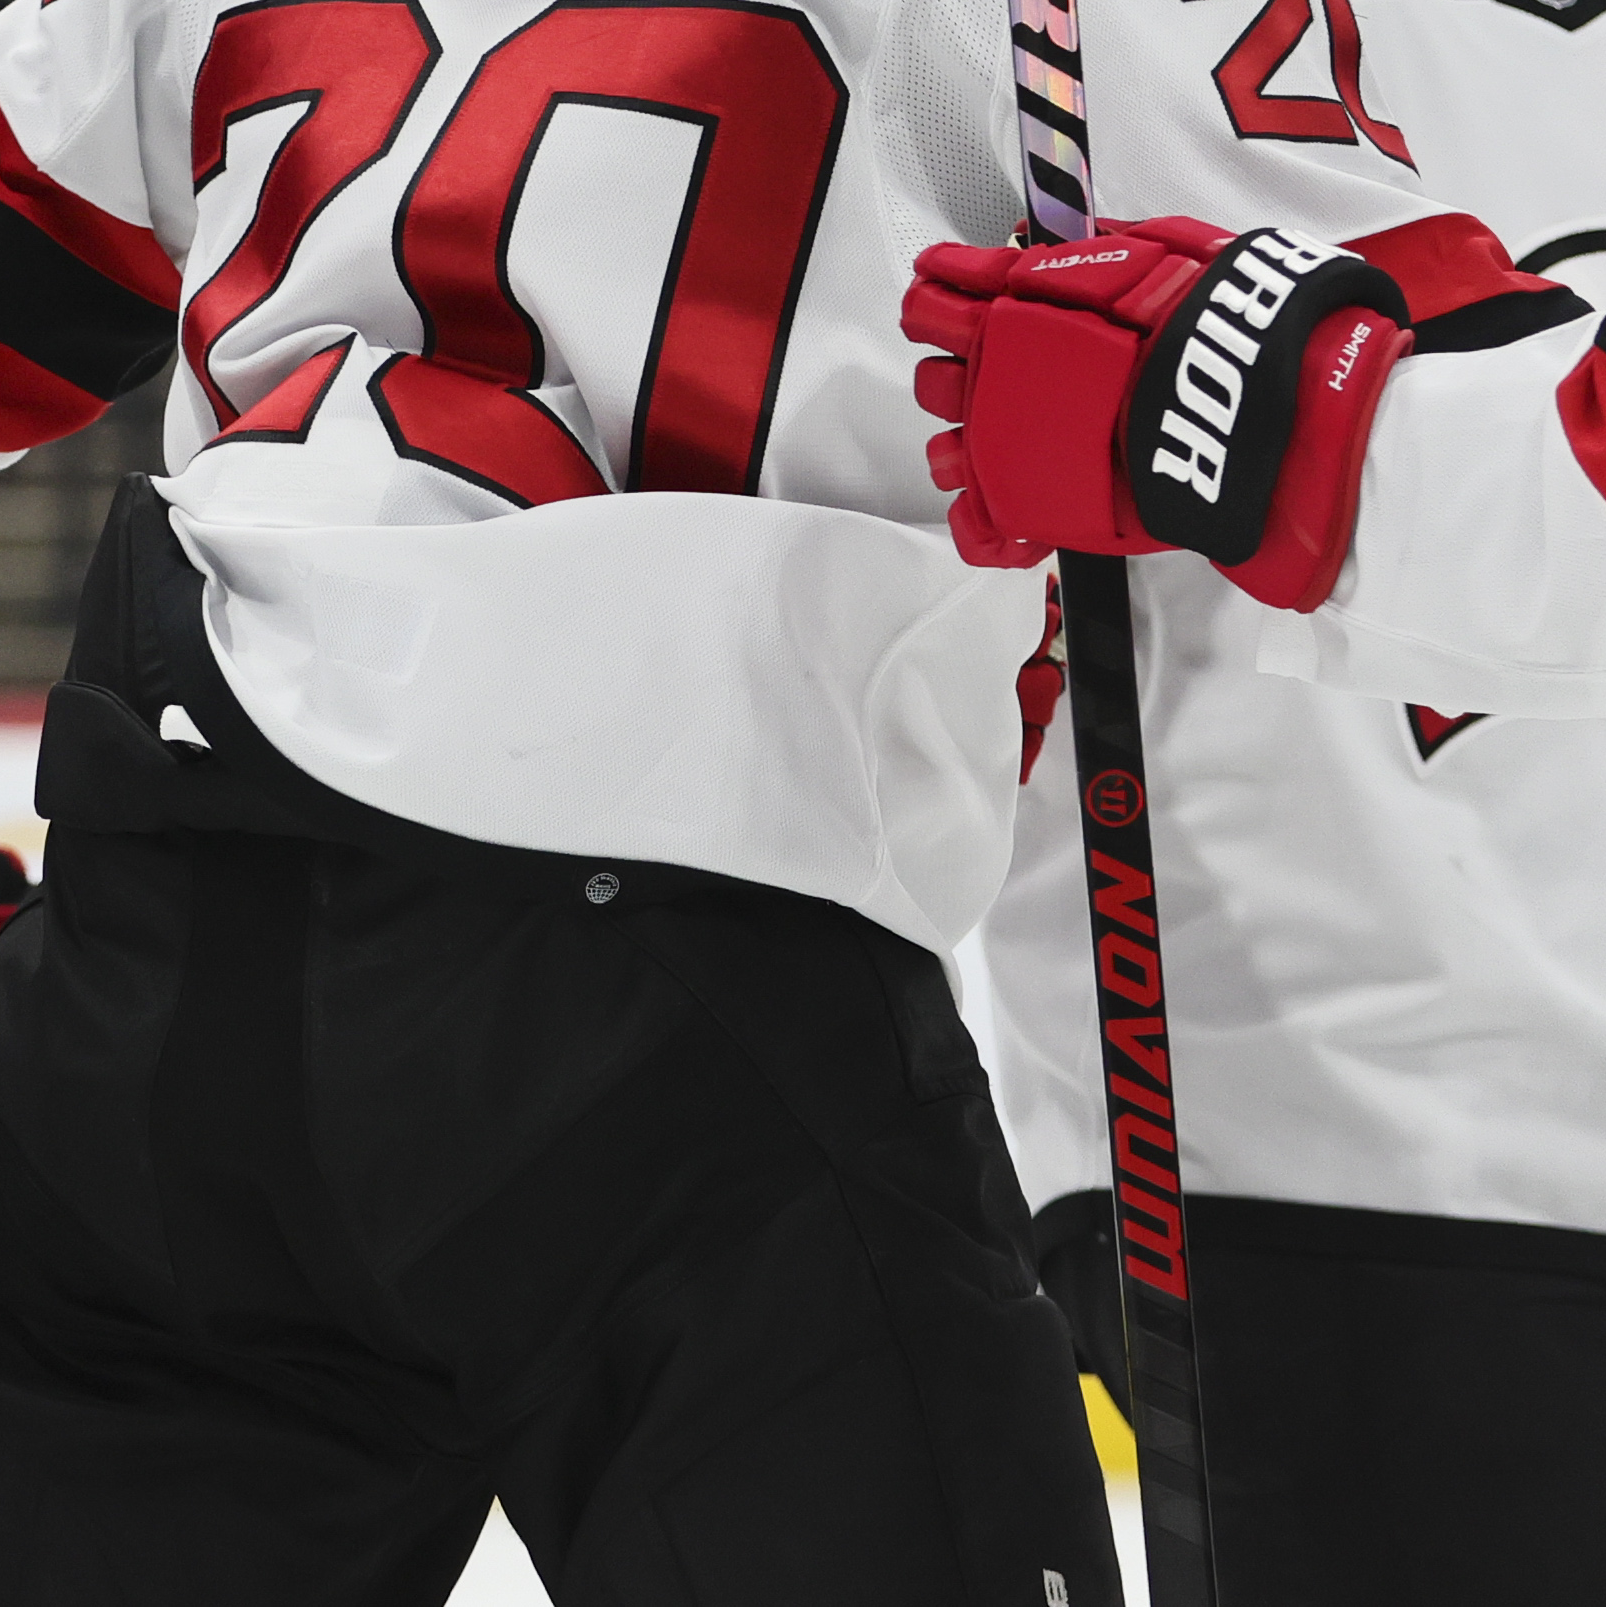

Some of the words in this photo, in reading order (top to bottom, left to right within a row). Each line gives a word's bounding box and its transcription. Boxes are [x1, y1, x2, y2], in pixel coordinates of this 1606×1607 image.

[1030, 249, 1130, 271] COVERT
[1328, 321, 1372, 392] SMITH
[1088, 848, 1187, 1302] NOVIUM
